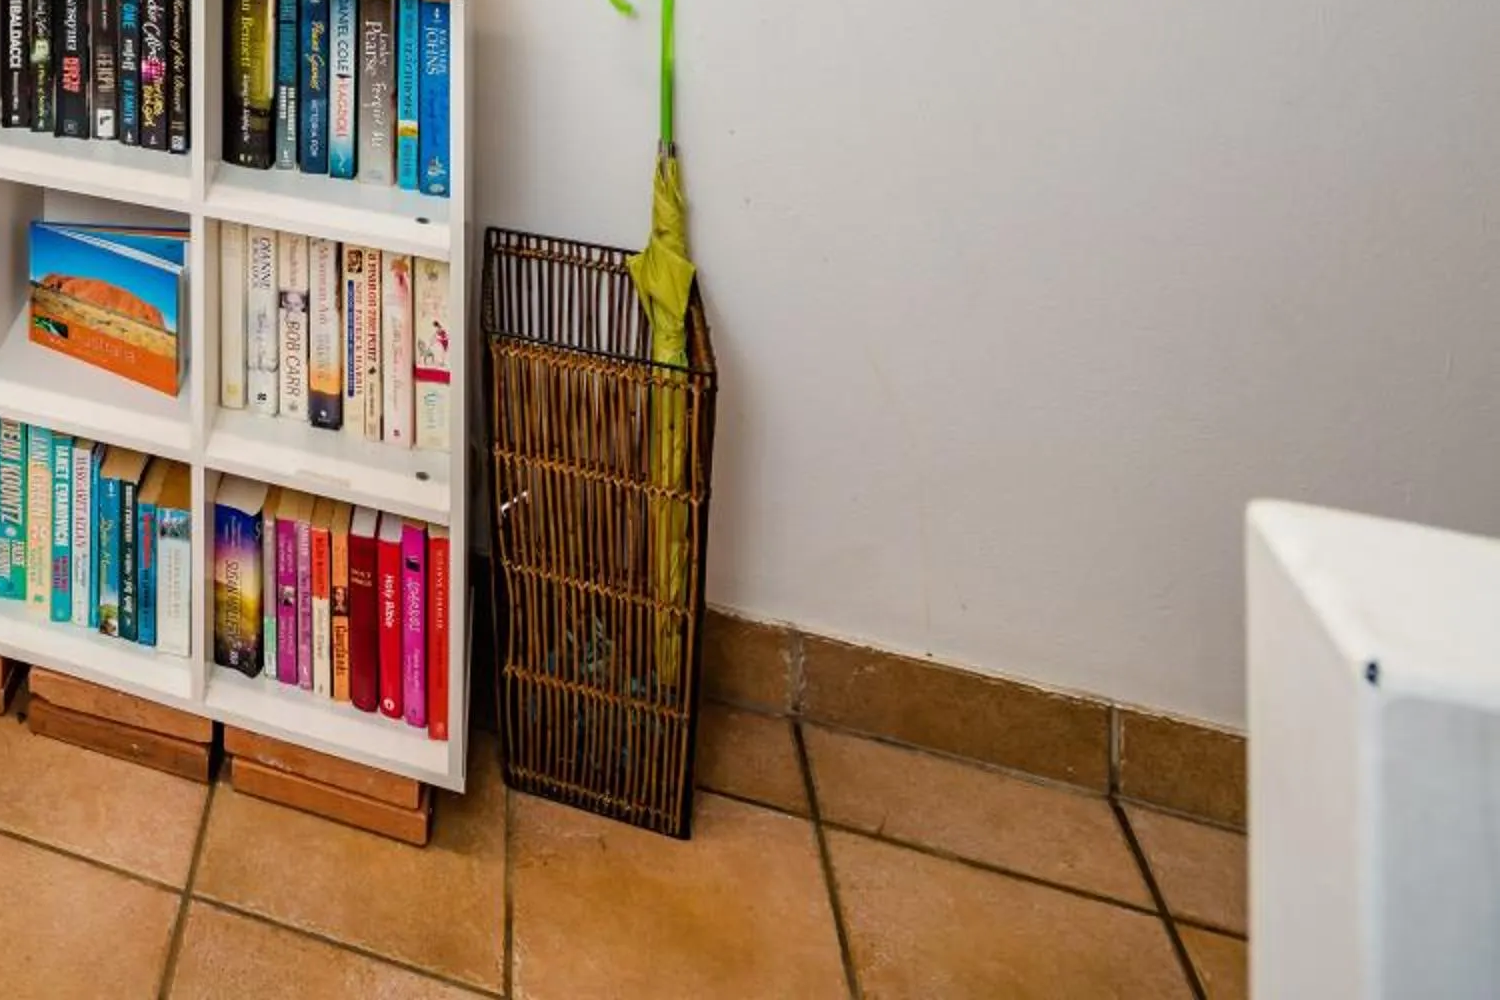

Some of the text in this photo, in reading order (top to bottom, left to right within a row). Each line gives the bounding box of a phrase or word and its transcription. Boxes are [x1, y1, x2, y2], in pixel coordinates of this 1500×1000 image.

[9, 4, 23, 69] BALDACCI
[122, 3, 136, 29] ONE
[239, 16, 253, 68] Bennett
[336, 40, 350, 72] COLE
[364, 20, 383, 77] Pearse
[424, 26, 441, 76] JOHNS
[284, 320, 301, 398] BOB CARR
[0, 462, 24, 526] KOONTZ
[384, 573, 395, 629] Holy Bible
